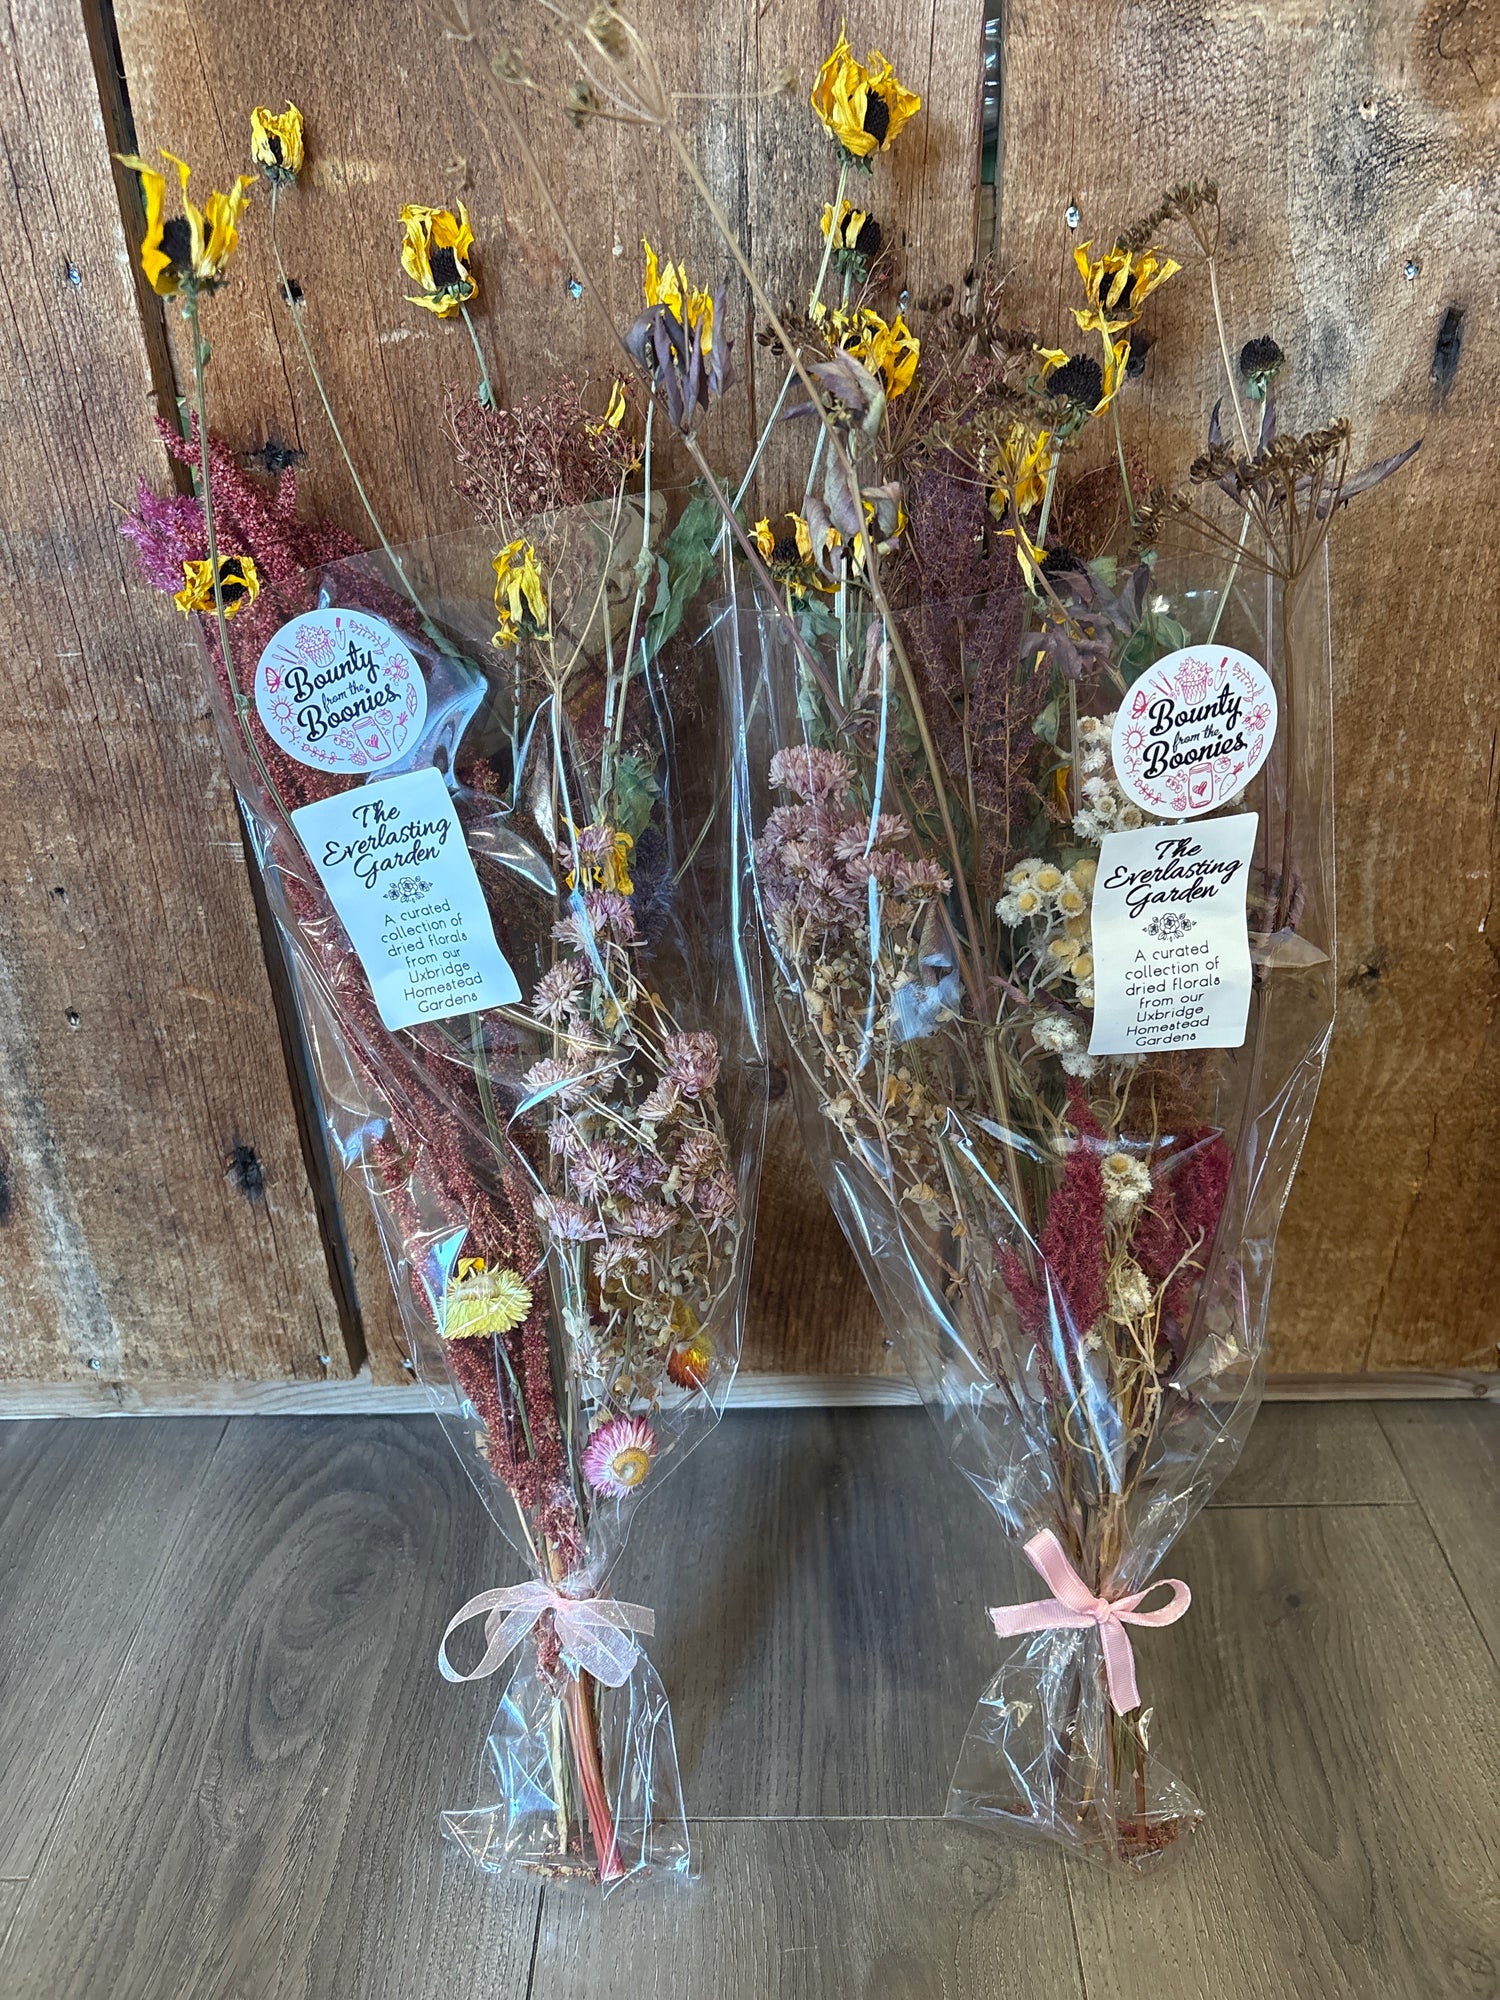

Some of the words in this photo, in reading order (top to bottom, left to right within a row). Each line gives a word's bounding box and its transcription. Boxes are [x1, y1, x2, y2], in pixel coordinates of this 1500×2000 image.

[285, 640, 380, 703] Bounty
[321, 692, 348, 713] from
[347, 680, 366, 700] the
[1149, 683, 1243, 737] Bounty
[297, 683, 402, 742] Boonies
[1173, 730, 1200, 753] from
[1202, 724, 1220, 740] the
[1143, 731, 1248, 780] Boonies
[352, 800, 401, 828] The
[323, 818, 451, 867] Everlasting
[1155, 837, 1202, 860] The
[353, 839, 440, 889] Garden
[1104, 858, 1243, 890] Everlasting
[1125, 877, 1219, 919] Garden
[384, 914, 396, 926] A
[400, 900, 451, 921] curated
[381, 919, 446, 944] collection
[450, 913, 463, 926] of
[387, 941, 424, 957] dried
[428, 931, 468, 949] florals
[1134, 949, 1146, 962] A
[1152, 940, 1209, 960] curated
[405, 953, 438, 969] from
[443, 948, 461, 960] our
[409, 960, 470, 984] Uxbridge
[1124, 961, 1199, 981] collection
[1205, 956, 1220, 970] of
[403, 973, 483, 1001] Homestead
[1125, 982, 1166, 996] dried
[1173, 977, 1221, 992] florals
[1140, 997, 1174, 1008] from
[1180, 992, 1205, 1003] our
[417, 992, 478, 1014] Gardens
[1136, 1006, 1204, 1022] Uxbridge
[1126, 1016, 1210, 1036] Homestead
[1135, 1032, 1197, 1047] Gardens
